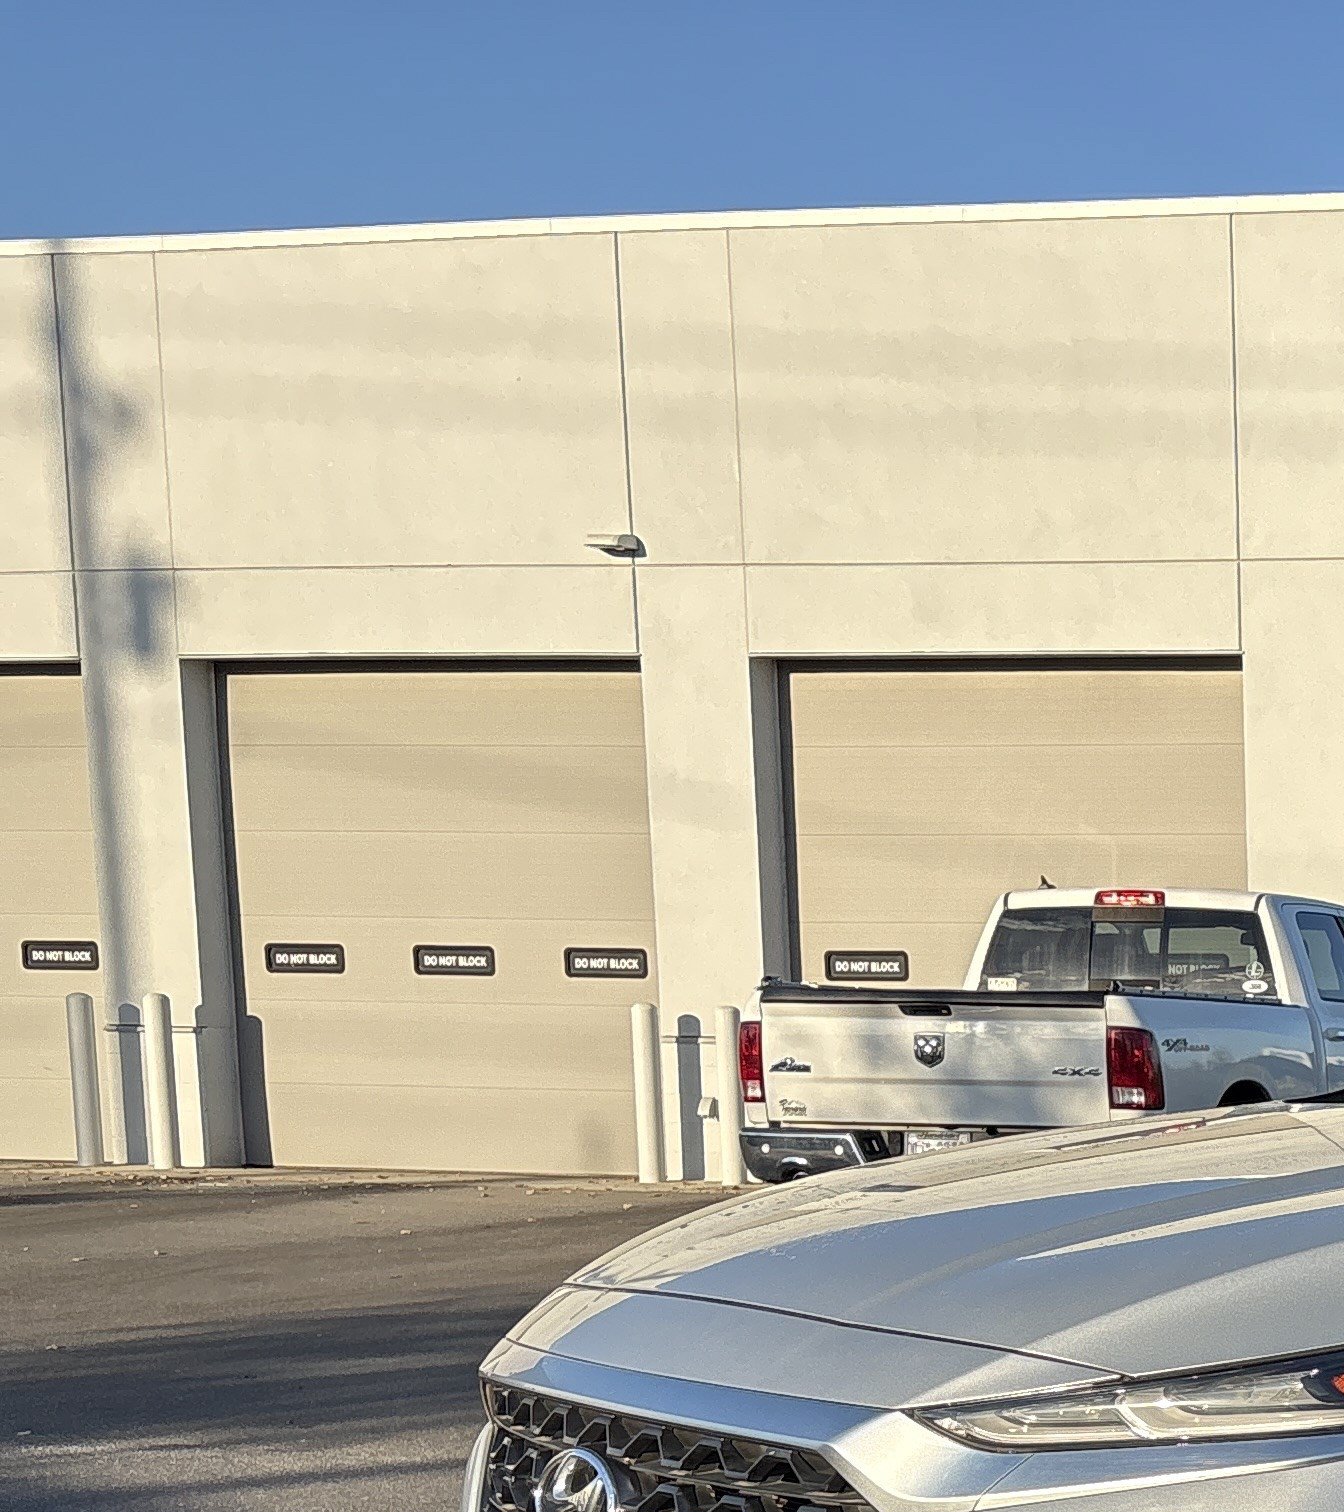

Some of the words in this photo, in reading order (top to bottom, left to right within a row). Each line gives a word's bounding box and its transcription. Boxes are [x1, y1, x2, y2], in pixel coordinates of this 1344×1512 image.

[32, 950, 45, 961] DO
[46, 950, 64, 962] NOT
[65, 951, 92, 962] BLOCK
[275, 953, 289, 964] DO
[290, 953, 308, 965] NOT
[309, 953, 338, 965] BLOCK
[423, 955, 438, 966] DO
[439, 955, 456, 967] NOT
[458, 955, 488, 968] BLOCK
[574, 957, 589, 969] DO
[590, 957, 608, 969] NOT
[609, 958, 639, 970] BLOCK
[835, 960, 849, 972] DO
[850, 961, 869, 972] NOT
[870, 961, 900, 973] BLOCK
